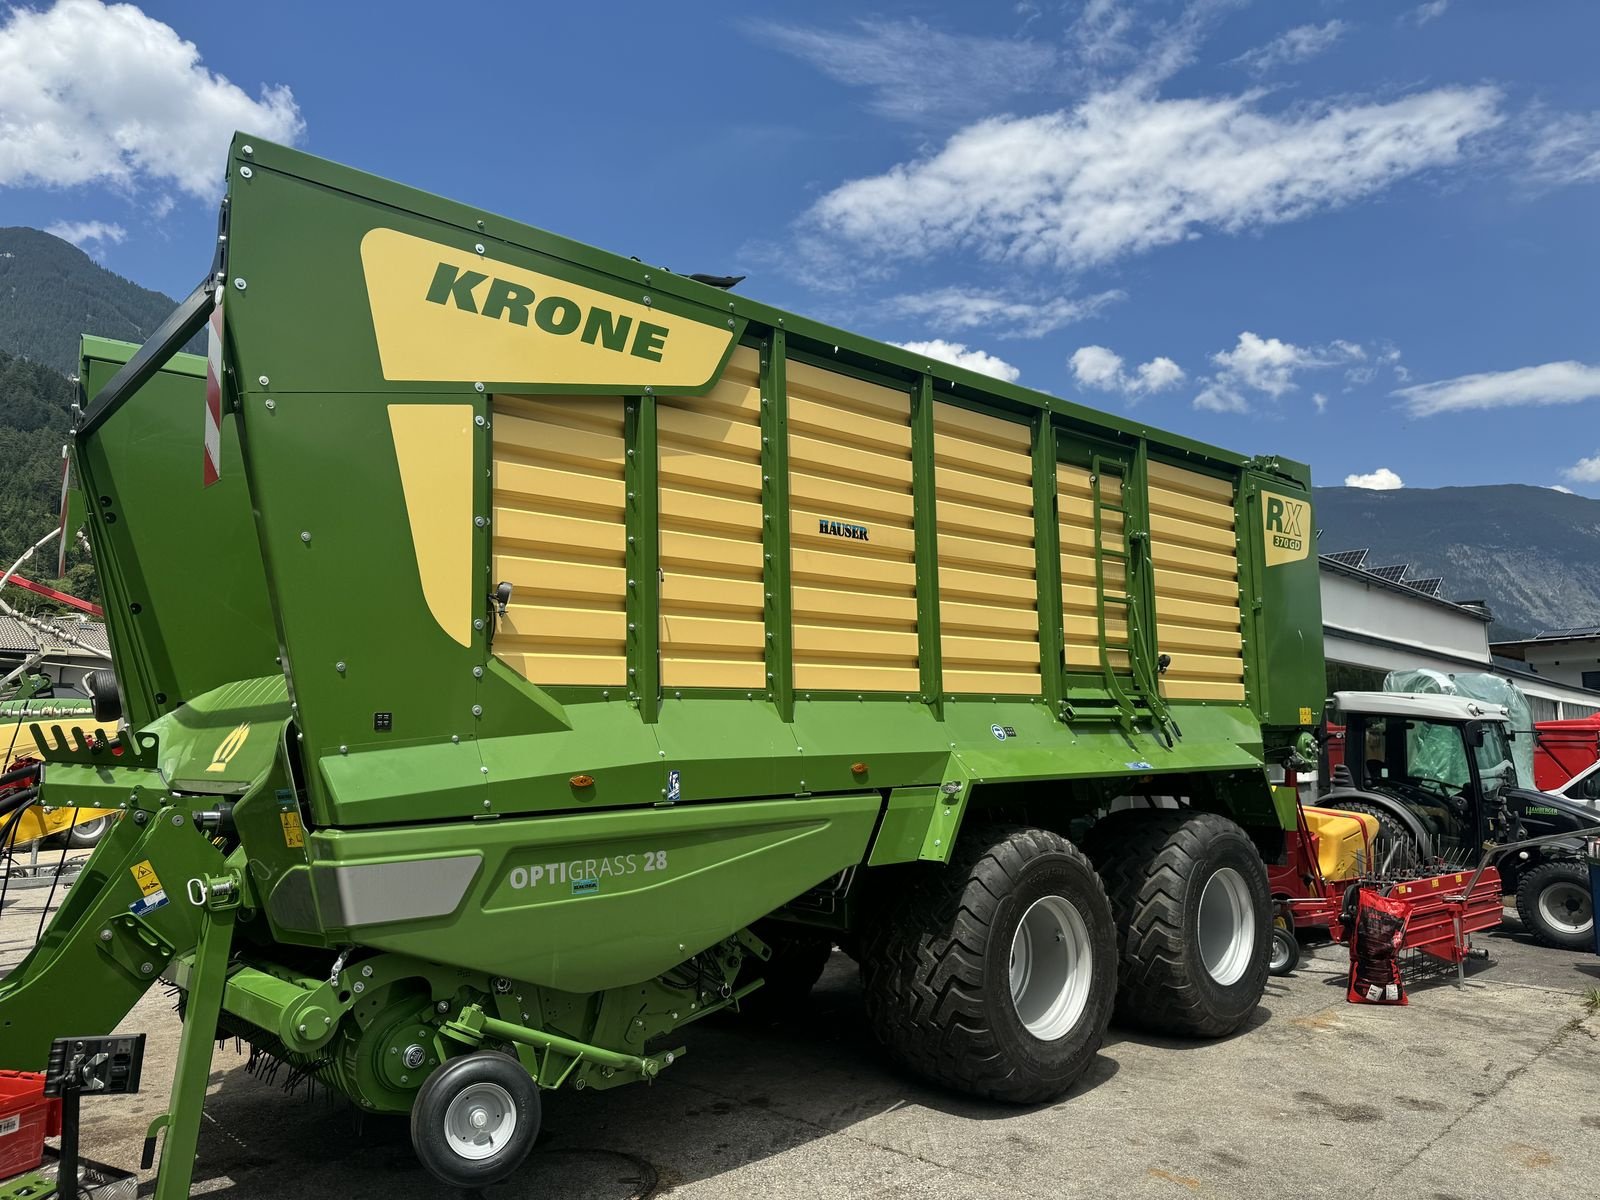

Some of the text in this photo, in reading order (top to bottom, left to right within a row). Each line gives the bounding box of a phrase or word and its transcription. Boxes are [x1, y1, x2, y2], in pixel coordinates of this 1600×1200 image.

[425, 262, 670, 363] KRONE
[819, 519, 869, 541] HAUSER
[1266, 497, 1302, 537] RX
[1274, 537, 1301, 550] 370 GD
[509, 850, 668, 889] OPTIGRASS 28
